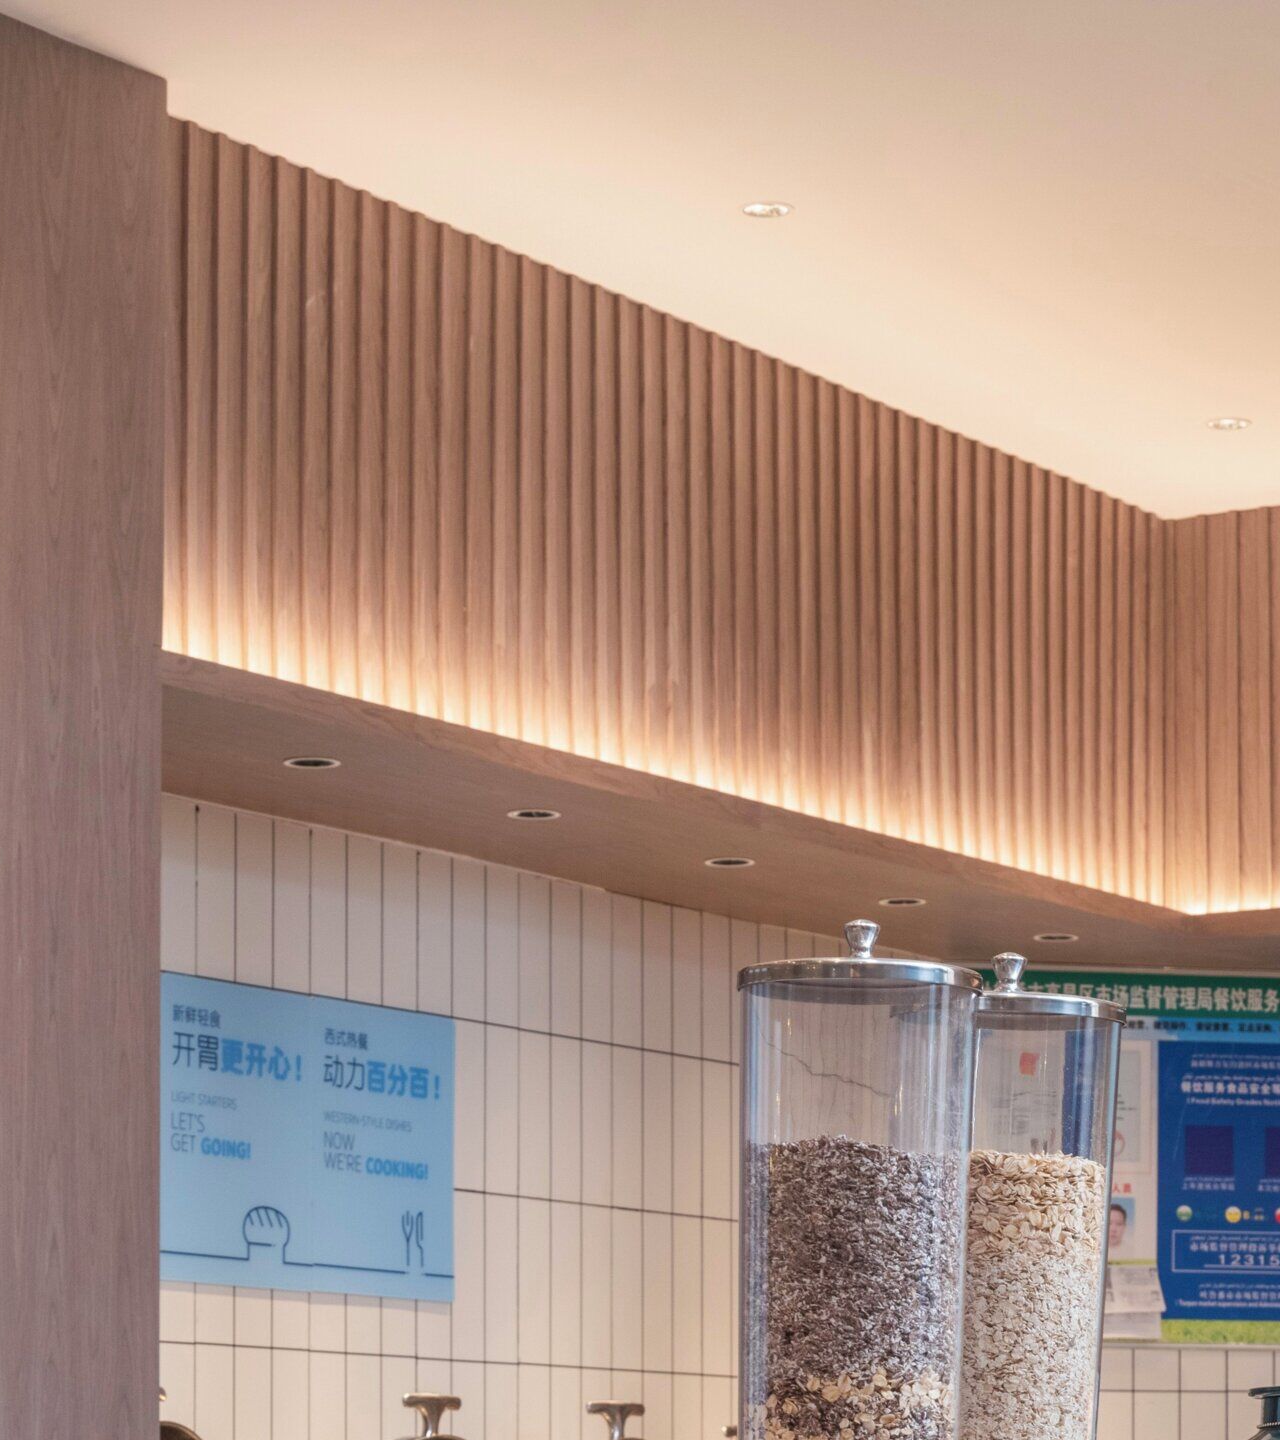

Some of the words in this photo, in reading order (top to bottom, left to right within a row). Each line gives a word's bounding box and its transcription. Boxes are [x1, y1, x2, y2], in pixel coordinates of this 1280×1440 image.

[172, 1004, 221, 1029] 新鲜轻食
[172, 1031, 302, 1082] 开胃更开心！
[323, 1054, 440, 1100] 动力百分百！
[171, 1112, 205, 1133] LET'S
[171, 1133, 196, 1152] GET
[201, 1137, 251, 1159] GOING!
[323, 1131, 355, 1151] NOW
[323, 1152, 362, 1173] WE'RE
[365, 1157, 429, 1180] COOKING!
[1218, 1254, 1280, 1267] 12315
